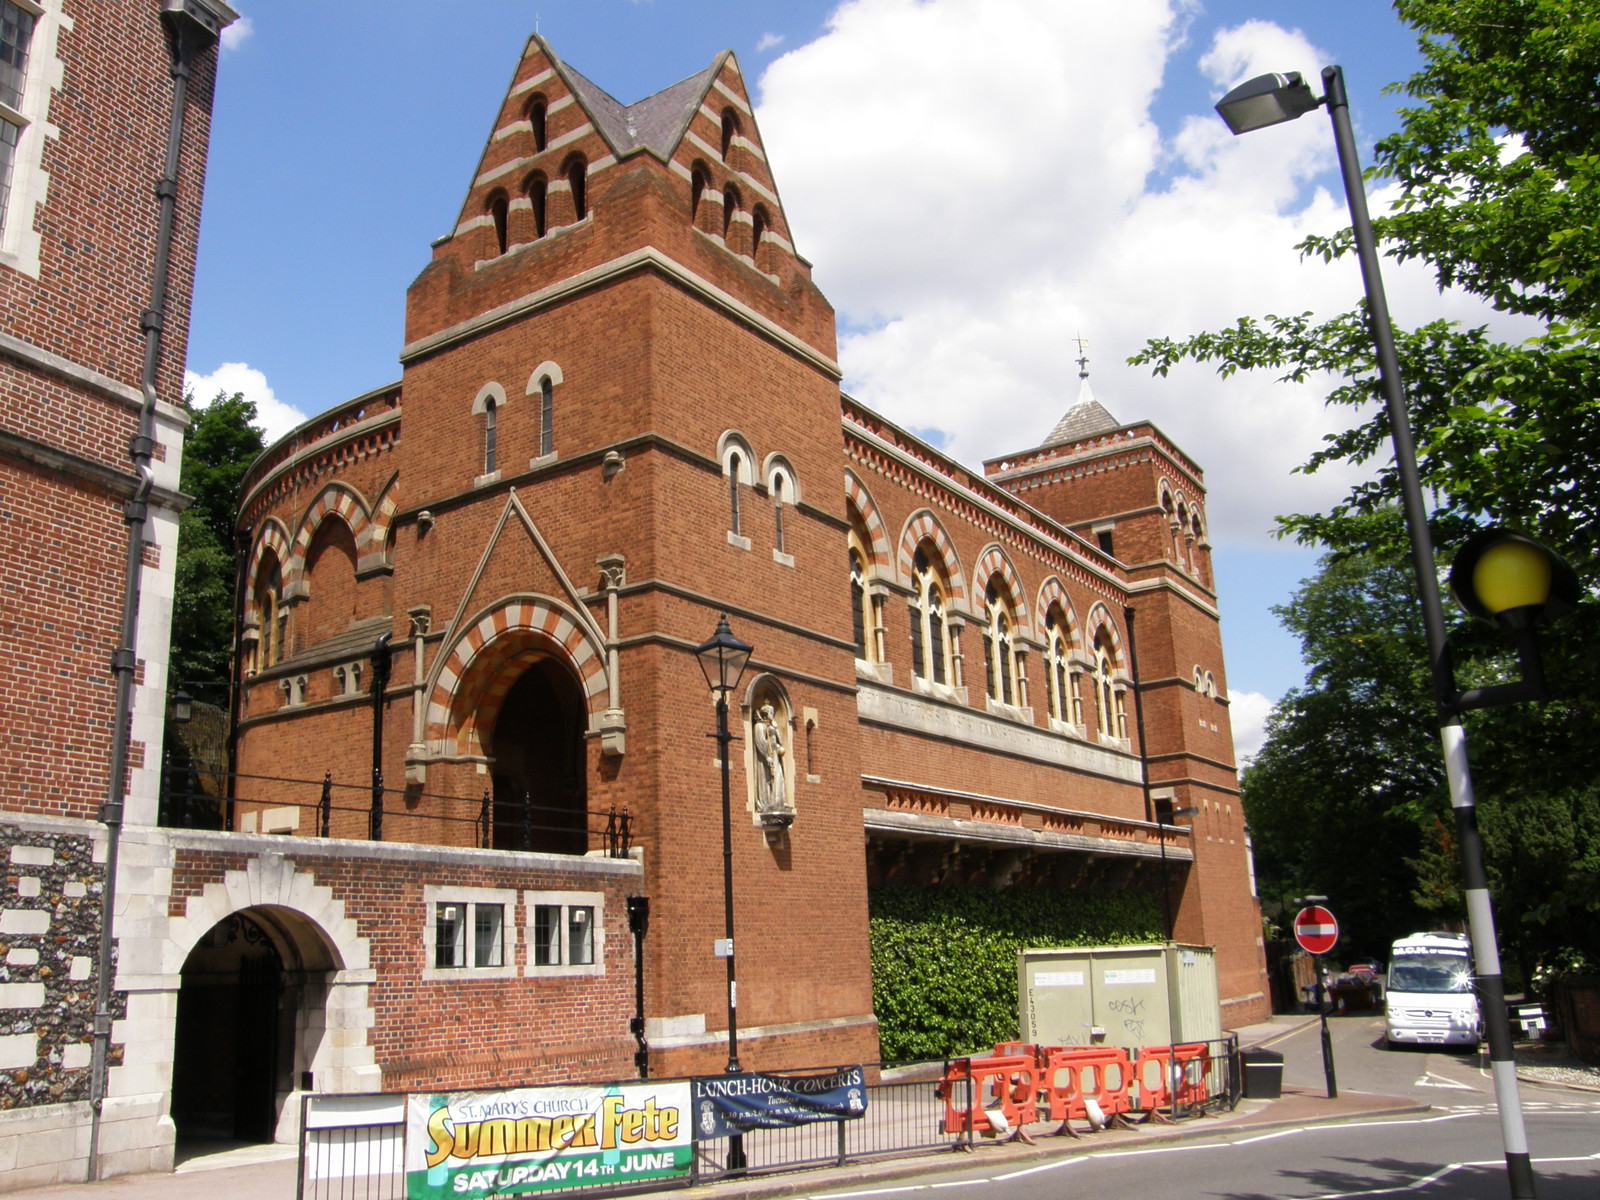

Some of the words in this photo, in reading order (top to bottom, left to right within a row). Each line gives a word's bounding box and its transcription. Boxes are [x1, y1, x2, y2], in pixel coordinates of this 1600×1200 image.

[697, 1078, 791, 1098] LUNCH-HOUR
[793, 1069, 861, 1093] CONCERTS
[459, 1105, 477, 1119] ST.
[480, 1100, 528, 1117] MARY'S
[533, 1098, 589, 1114] CHURCH
[600, 1094, 679, 1150] Fete
[453, 1161, 572, 1193] SATURDAY
[620, 1152, 675, 1172] JUNE
